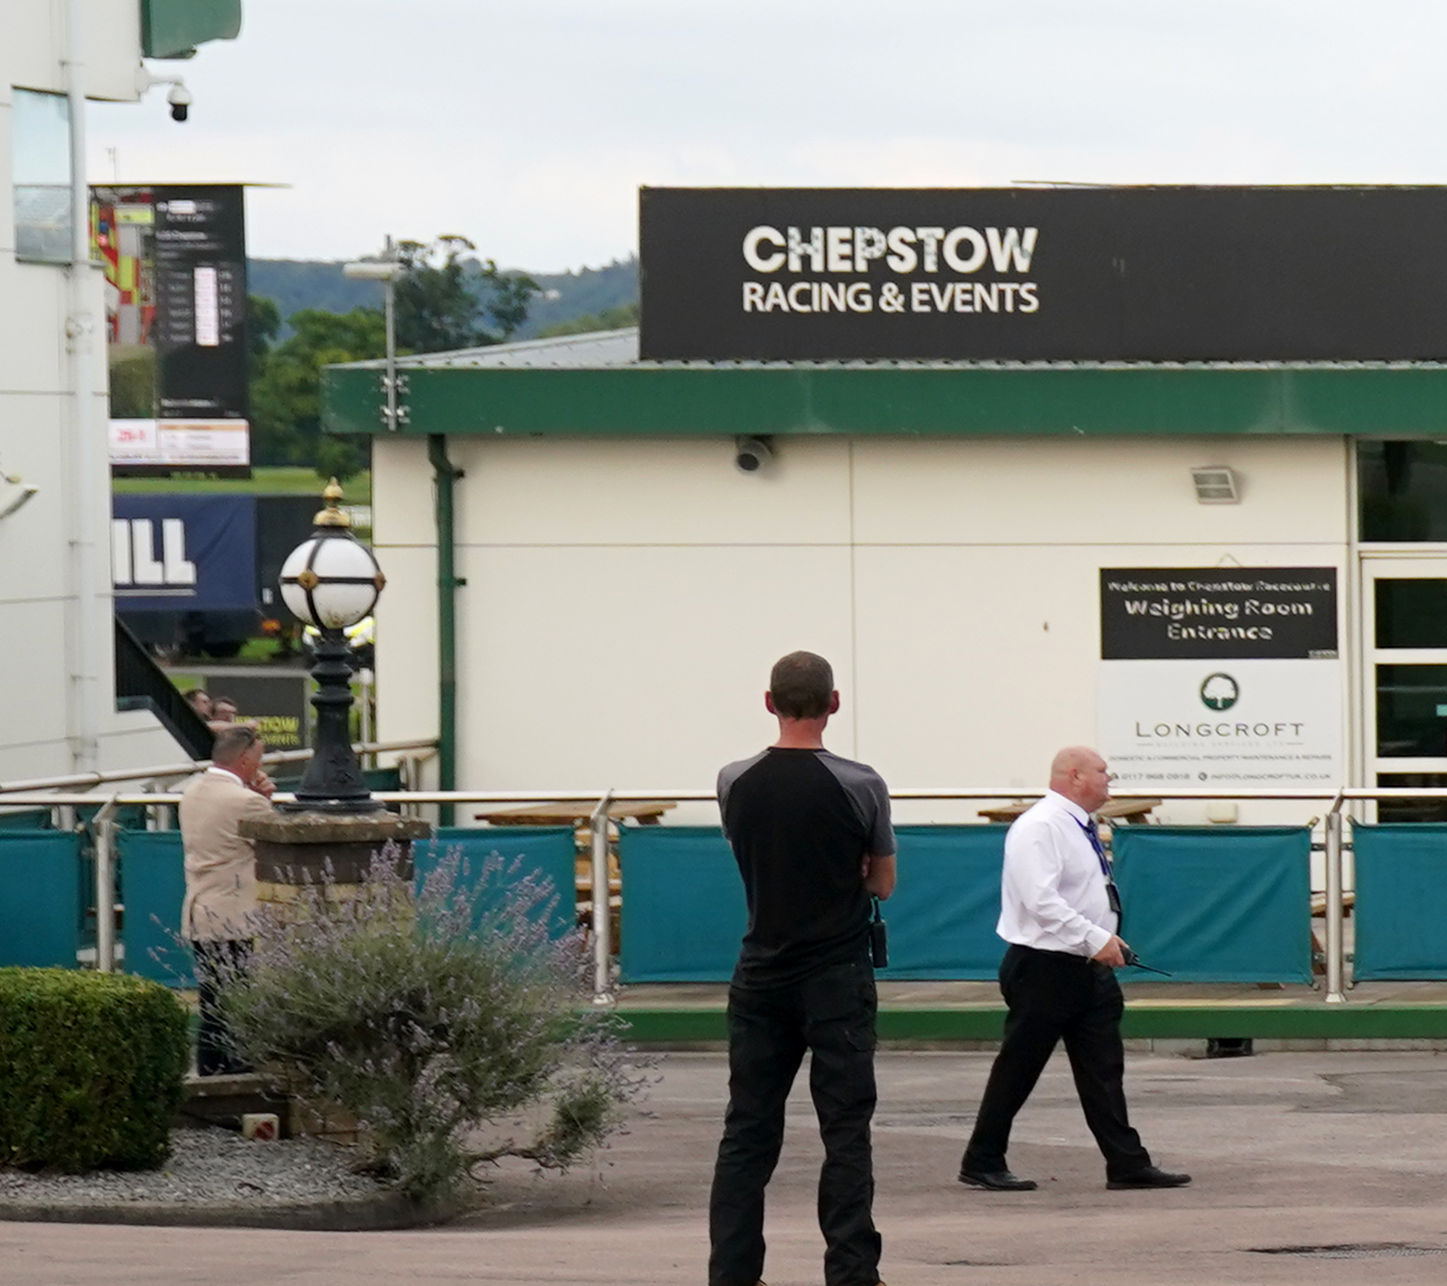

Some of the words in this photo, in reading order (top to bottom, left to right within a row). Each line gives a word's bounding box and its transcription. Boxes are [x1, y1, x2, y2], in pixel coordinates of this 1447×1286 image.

[742, 224, 1039, 274] CHEPSTOW
[743, 282, 873, 313] RACING
[878, 282, 906, 313] &
[911, 282, 1039, 313] EVENTS
[1124, 599, 1240, 620] Weighing
[1244, 600, 1313, 615] Room
[1167, 623, 1274, 640] Entrance
[1135, 721, 1305, 737] LONGCROFT
